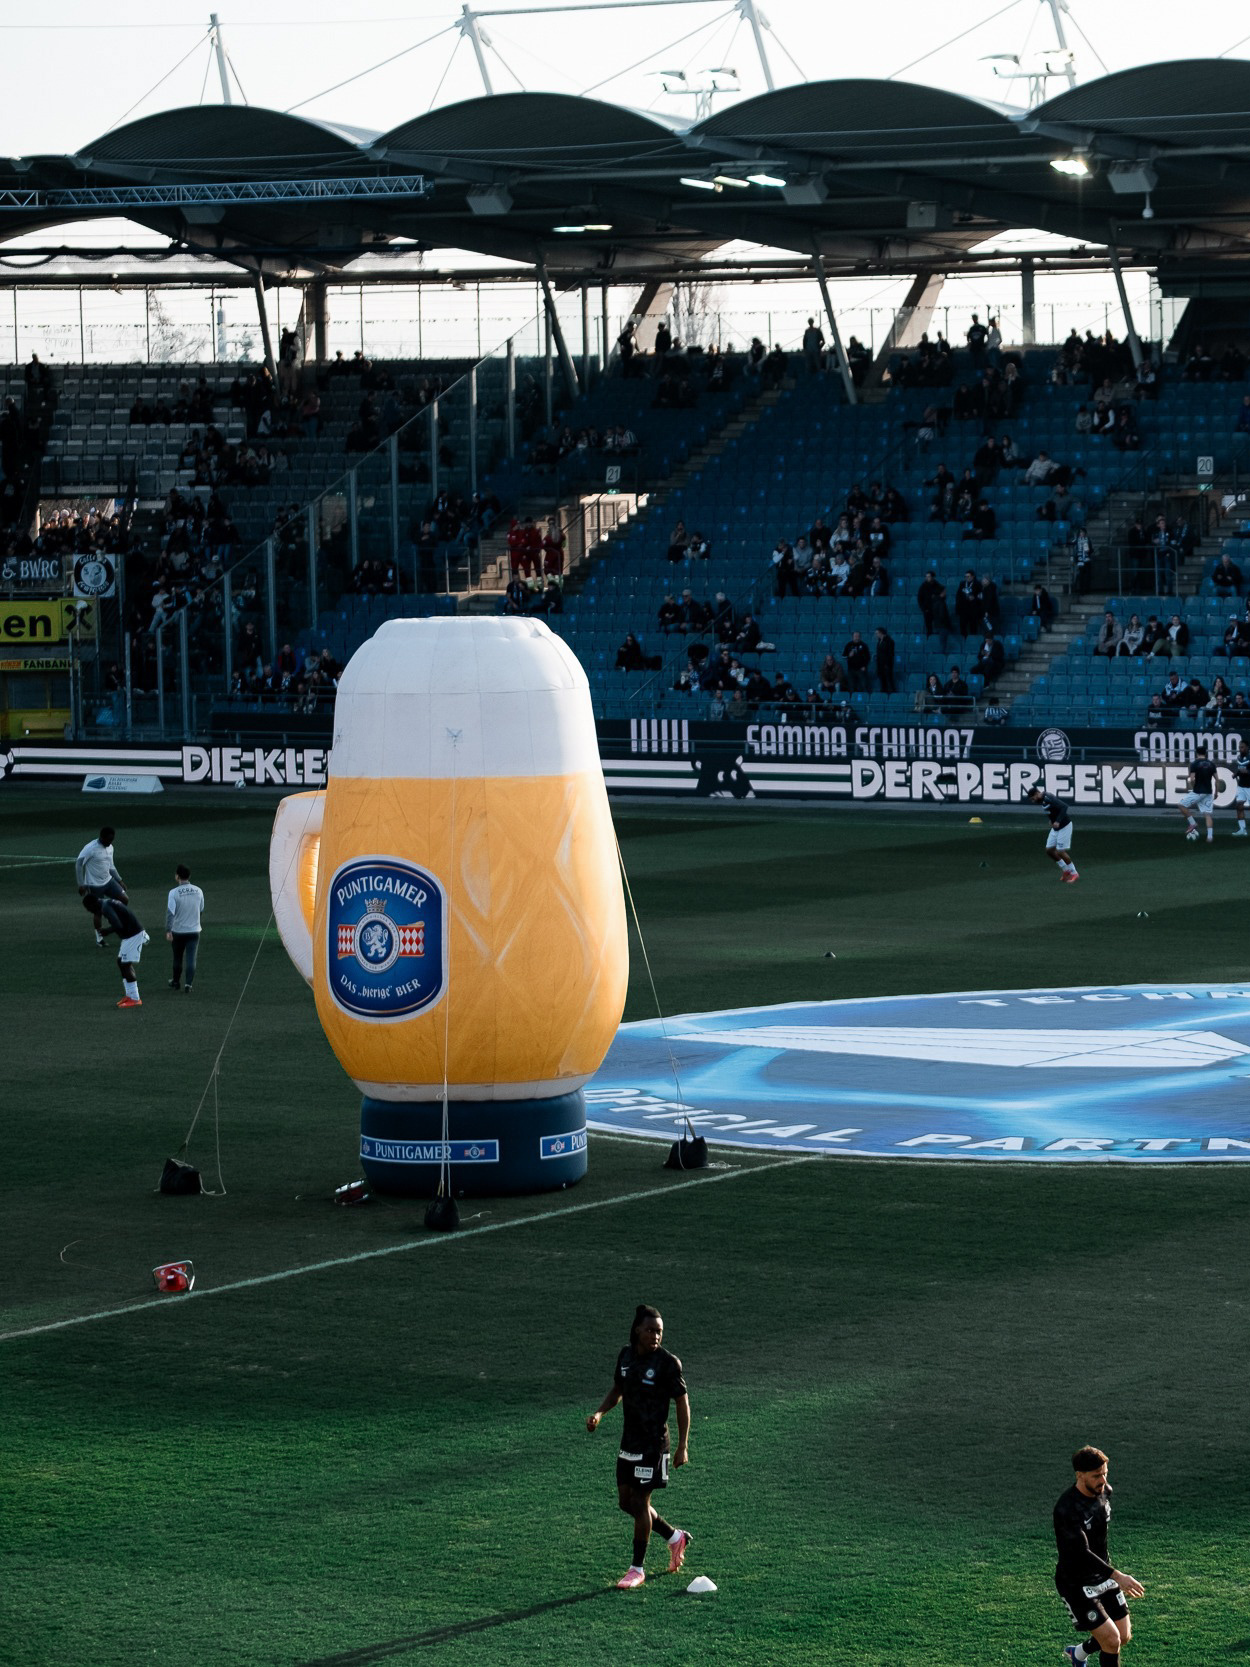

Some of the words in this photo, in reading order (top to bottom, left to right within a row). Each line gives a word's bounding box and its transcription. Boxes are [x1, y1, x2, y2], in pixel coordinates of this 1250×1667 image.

[607, 468, 619, 481] 21
[1198, 459, 1212, 472] 20
[20, 557, 59, 579] BWRC
[0, 614, 51, 637] en
[182, 745, 245, 784] DIE
[254, 747, 331, 785] KLE
[851, 759, 945, 801] DER
[957, 761, 1193, 806] PERFEKTE
[336, 875, 428, 908] PUNTIGAMER
[340, 974, 357, 994] DAS
[395, 978, 422, 997] BIER
[375, 1141, 452, 1160] PUNTIGAMER
